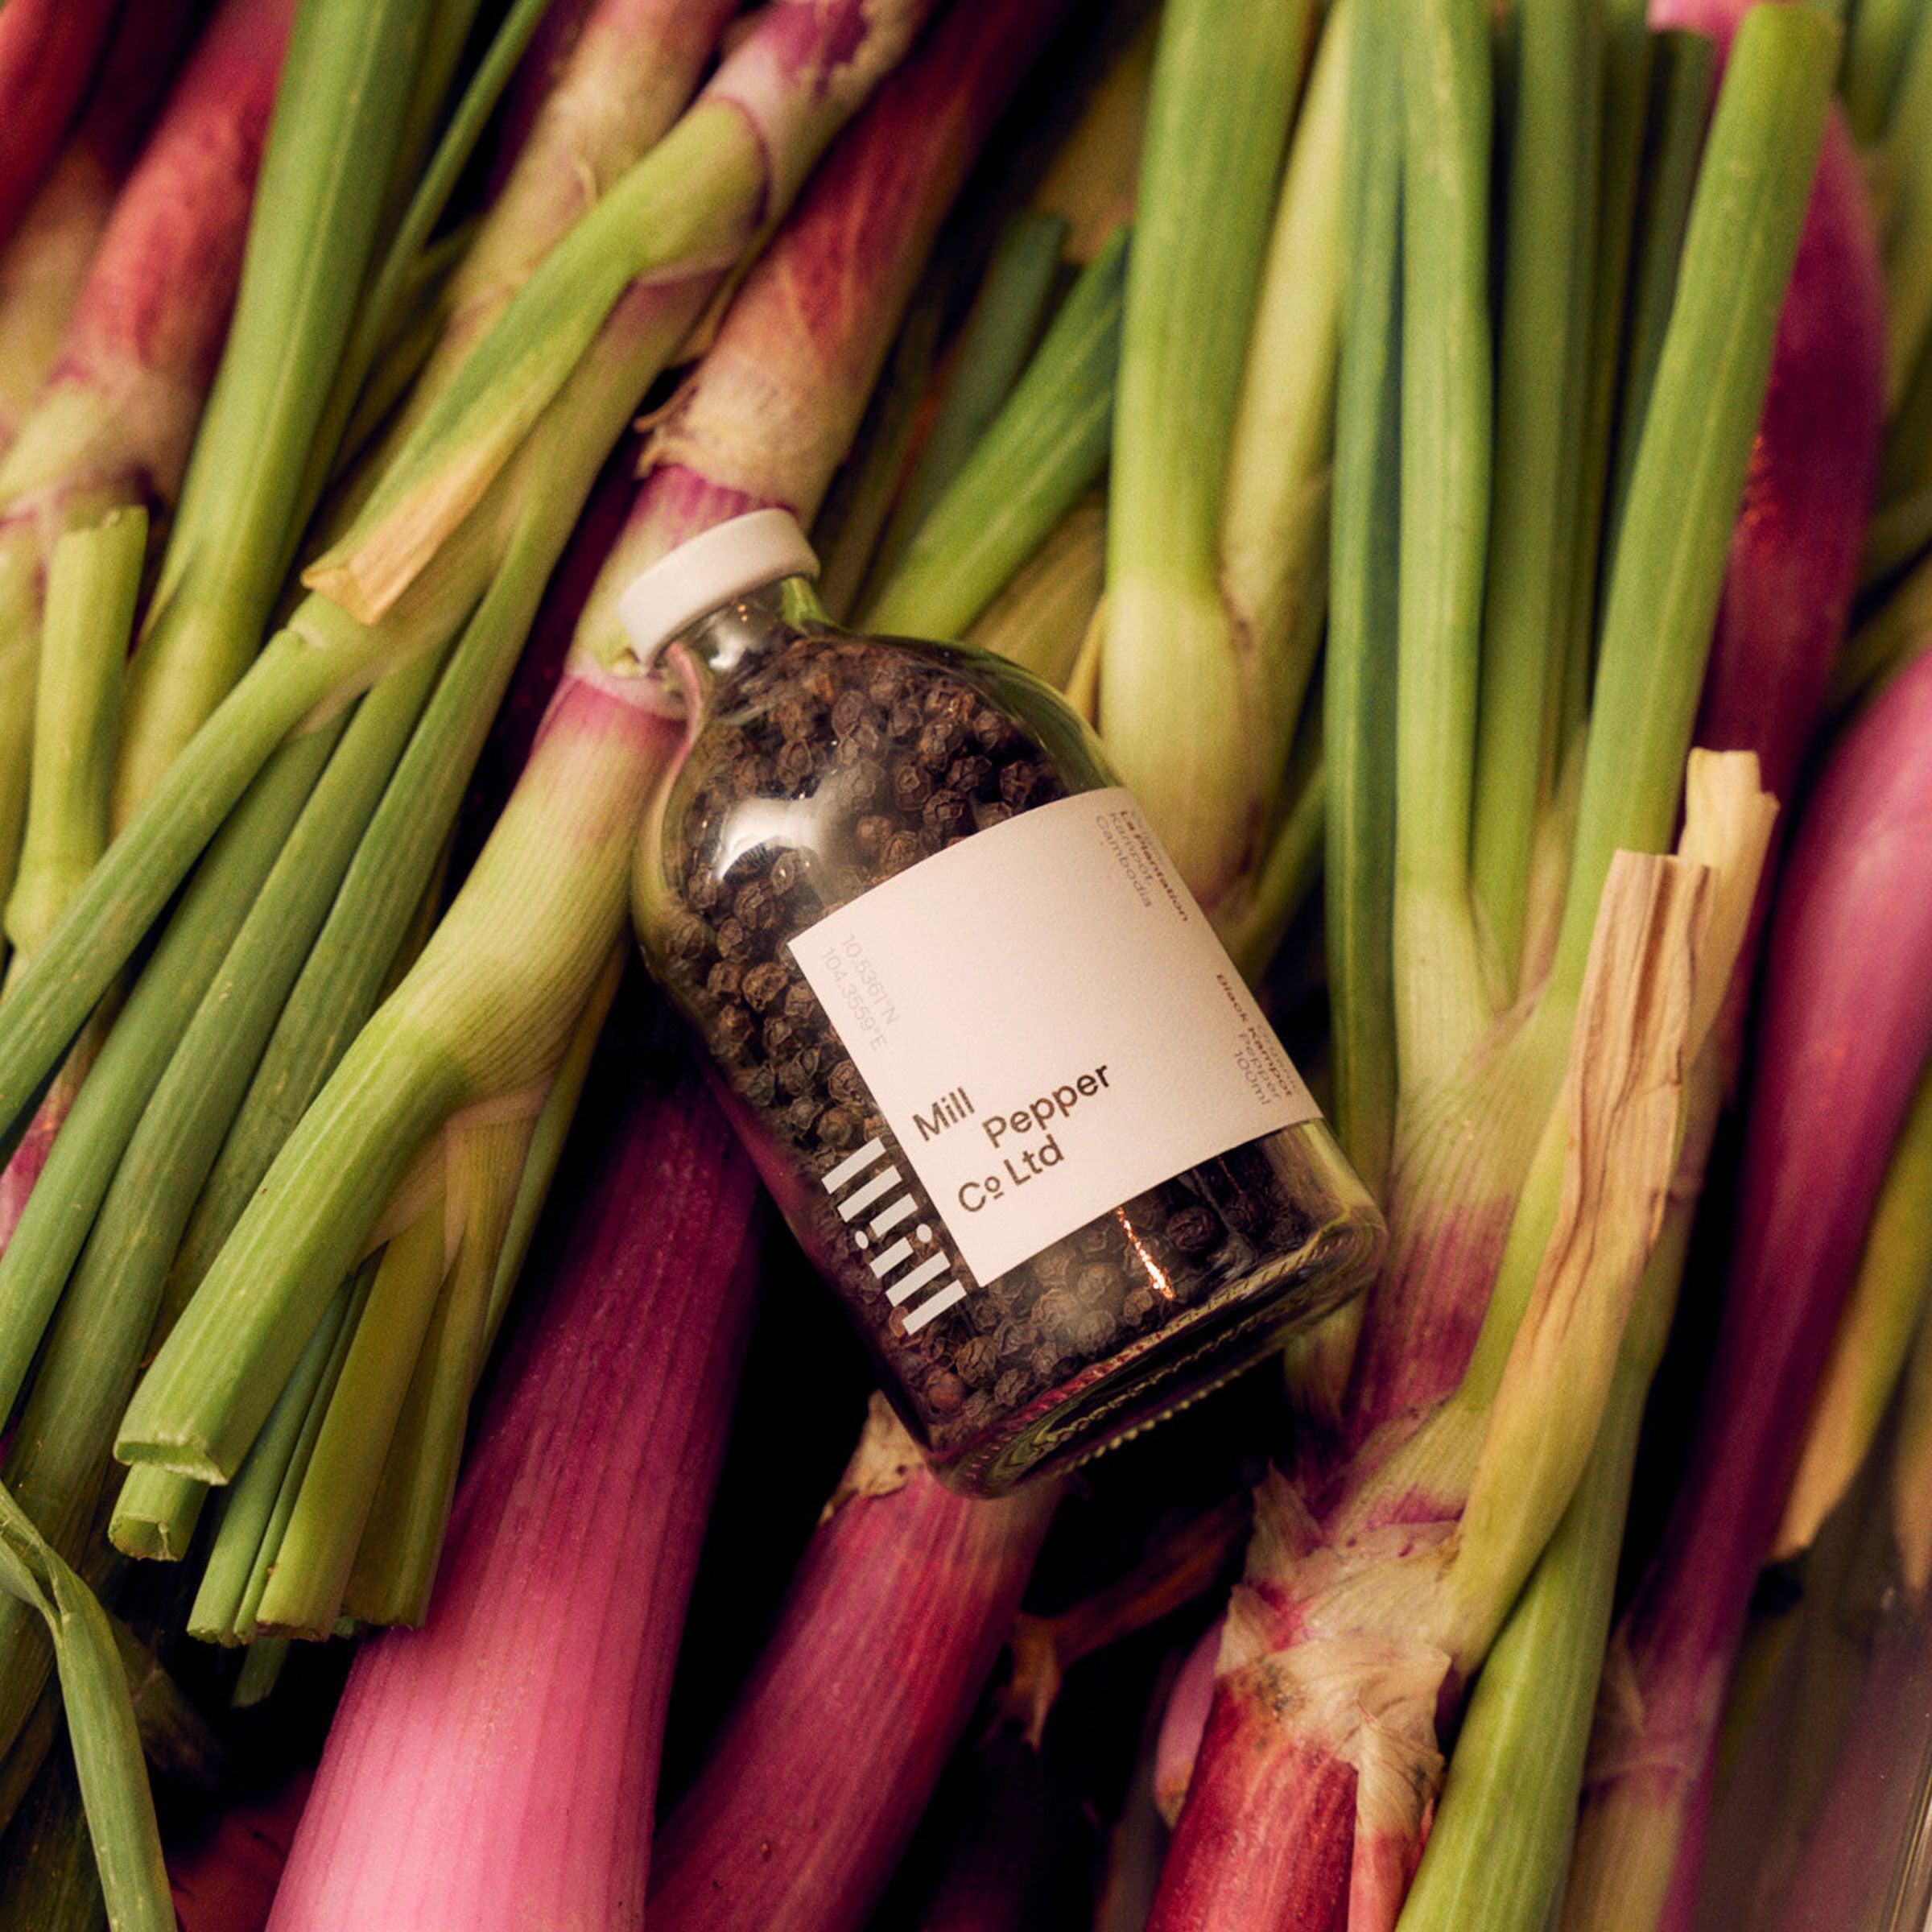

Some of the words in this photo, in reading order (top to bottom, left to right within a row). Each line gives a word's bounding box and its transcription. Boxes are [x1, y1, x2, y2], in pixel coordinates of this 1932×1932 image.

[1096, 815, 1151, 907] Cambodia
[1133, 834, 1188, 923] Plantation
[1216, 974, 1248, 1022] Black
[1248, 1027, 1293, 1096] Kampot
[1239, 1033, 1282, 1100] Pepper
[912, 1087, 975, 1141] Mill
[981, 1064, 1109, 1149] Pepper
[1234, 1051, 1271, 1104] 100ml
[1004, 1133, 1064, 1186] Ltd
